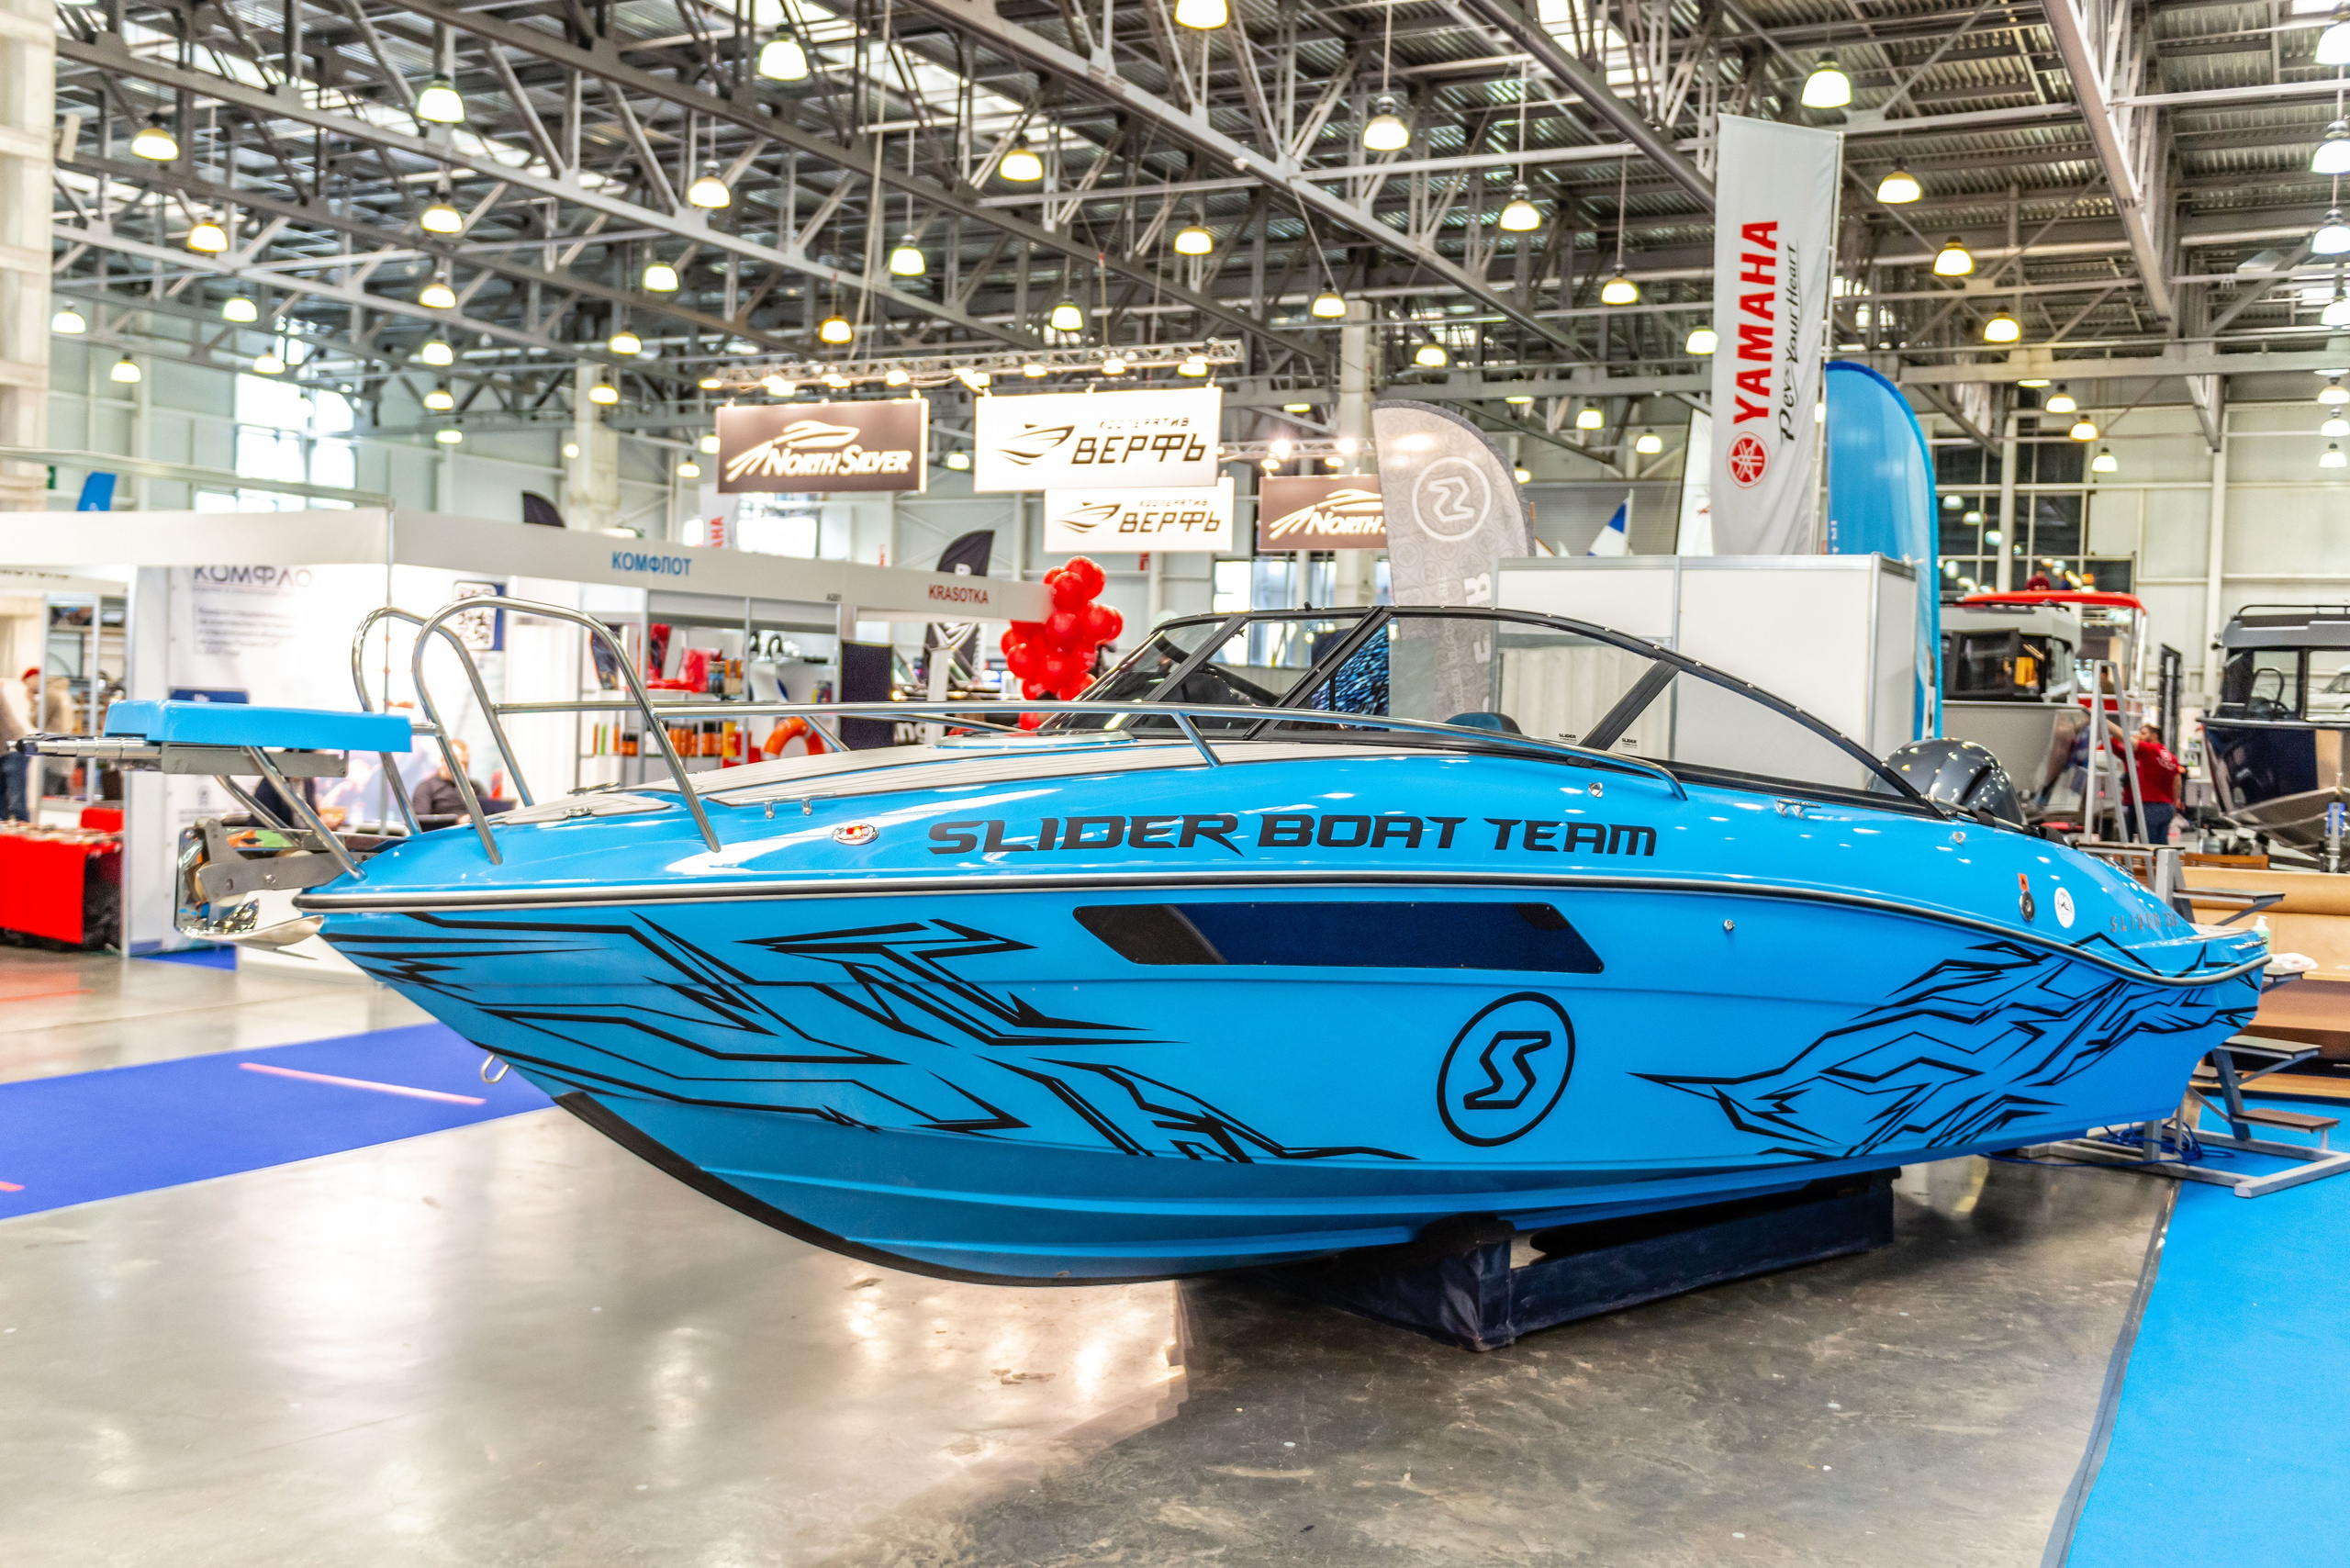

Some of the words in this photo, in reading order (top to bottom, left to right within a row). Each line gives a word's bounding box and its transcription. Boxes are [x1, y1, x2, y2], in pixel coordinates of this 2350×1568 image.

[1786, 242, 1798, 307] Heart
[1732, 220, 1779, 425] YAMAHA
[1785, 308, 1799, 364] Your
[1099, 417, 1190, 430] КООЕРАТИВ
[1070, 433, 1207, 465] ВЕРФЬ
[1118, 510, 1221, 533] ВЕРФЬ
[612, 551, 692, 576] КОМФЛОТ
[928, 584, 990, 604] KRASOTKA
[927, 814, 1245, 857] SLIDER
[1257, 814, 1468, 849] BOAT
[1483, 817, 1657, 857] TEAM
[2110, 912, 2162, 933] SLIDER
